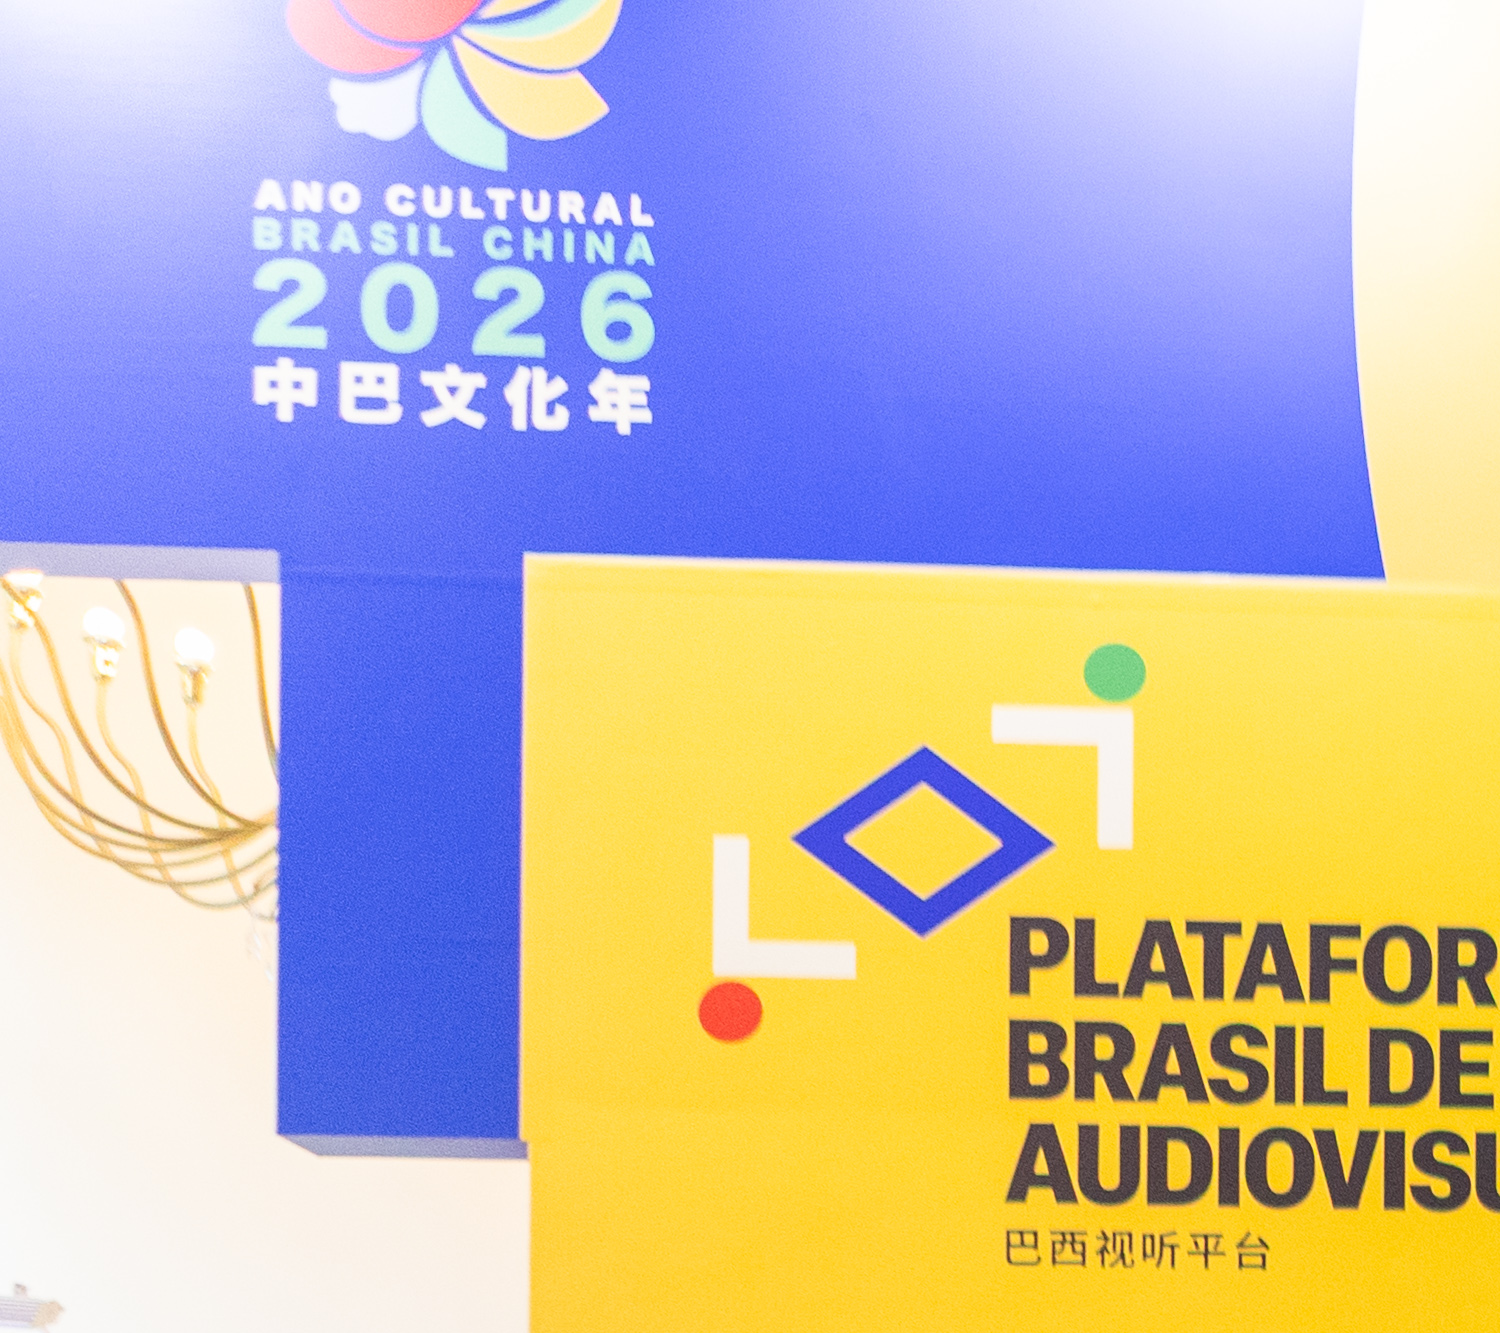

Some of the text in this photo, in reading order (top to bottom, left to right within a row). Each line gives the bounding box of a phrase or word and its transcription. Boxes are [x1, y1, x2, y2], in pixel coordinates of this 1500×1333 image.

[253, 178, 655, 228] ANO CULTURAL
[250, 215, 655, 266] BRASIL CHINA
[251, 257, 655, 363] 2026
[251, 356, 653, 436] 中巴文化年
[1008, 1019, 1495, 1110] BRASIL DE
[1005, 1229, 1271, 1271] 巴西视听平台
